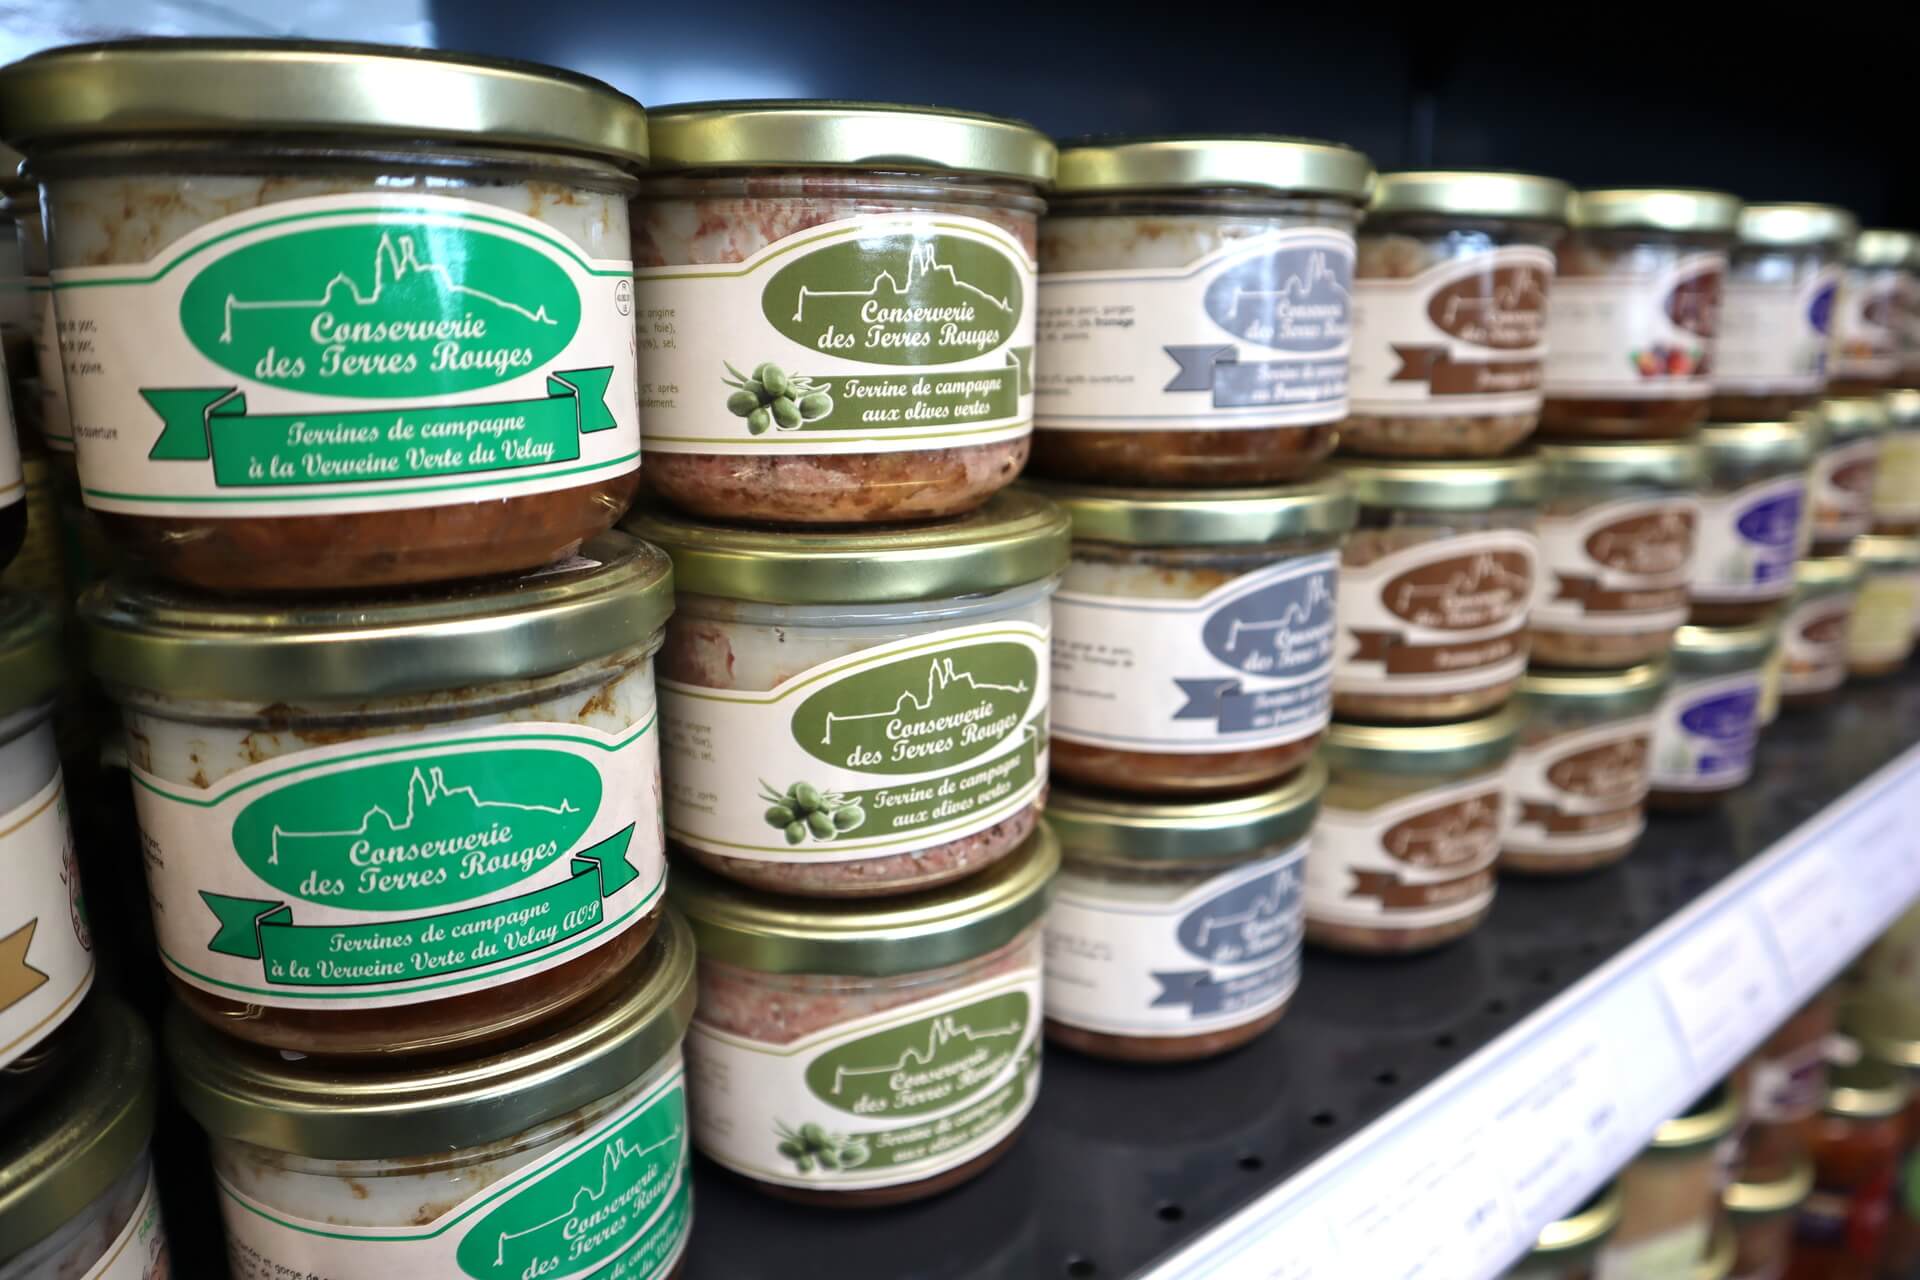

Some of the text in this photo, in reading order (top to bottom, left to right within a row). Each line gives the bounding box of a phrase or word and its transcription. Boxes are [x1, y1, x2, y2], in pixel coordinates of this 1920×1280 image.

[310, 311, 487, 345] Conserverie
[861, 300, 975, 323] Conserverie
[818, 322, 1000, 349] des Terres Rouges
[255, 340, 532, 379] des Terres Rouges
[843, 377, 1002, 399] Terrine de campagne
[287, 415, 525, 446] Terrines de campagne
[862, 400, 990, 423] aux olives vertes
[248, 438, 556, 479] à la Verveine Verte du Velay
[847, 712, 1018, 767] des Terres Rouges
[886, 700, 993, 740] Conserverie
[873, 786, 934, 808] Terrine
[937, 779, 956, 796] de
[892, 807, 928, 827] aux
[932, 796, 973, 820] olives
[349, 822, 512, 867] Conserverie
[300, 839, 557, 896] des Terres Rouges
[272, 899, 600, 979] à la Verveine Verte du Velay AOP
[329, 900, 550, 953] Terrines de campagne
[563, 1162, 659, 1240] Conserverie
[521, 1256, 559, 1280] des
[568, 1216, 626, 1261] Terres
